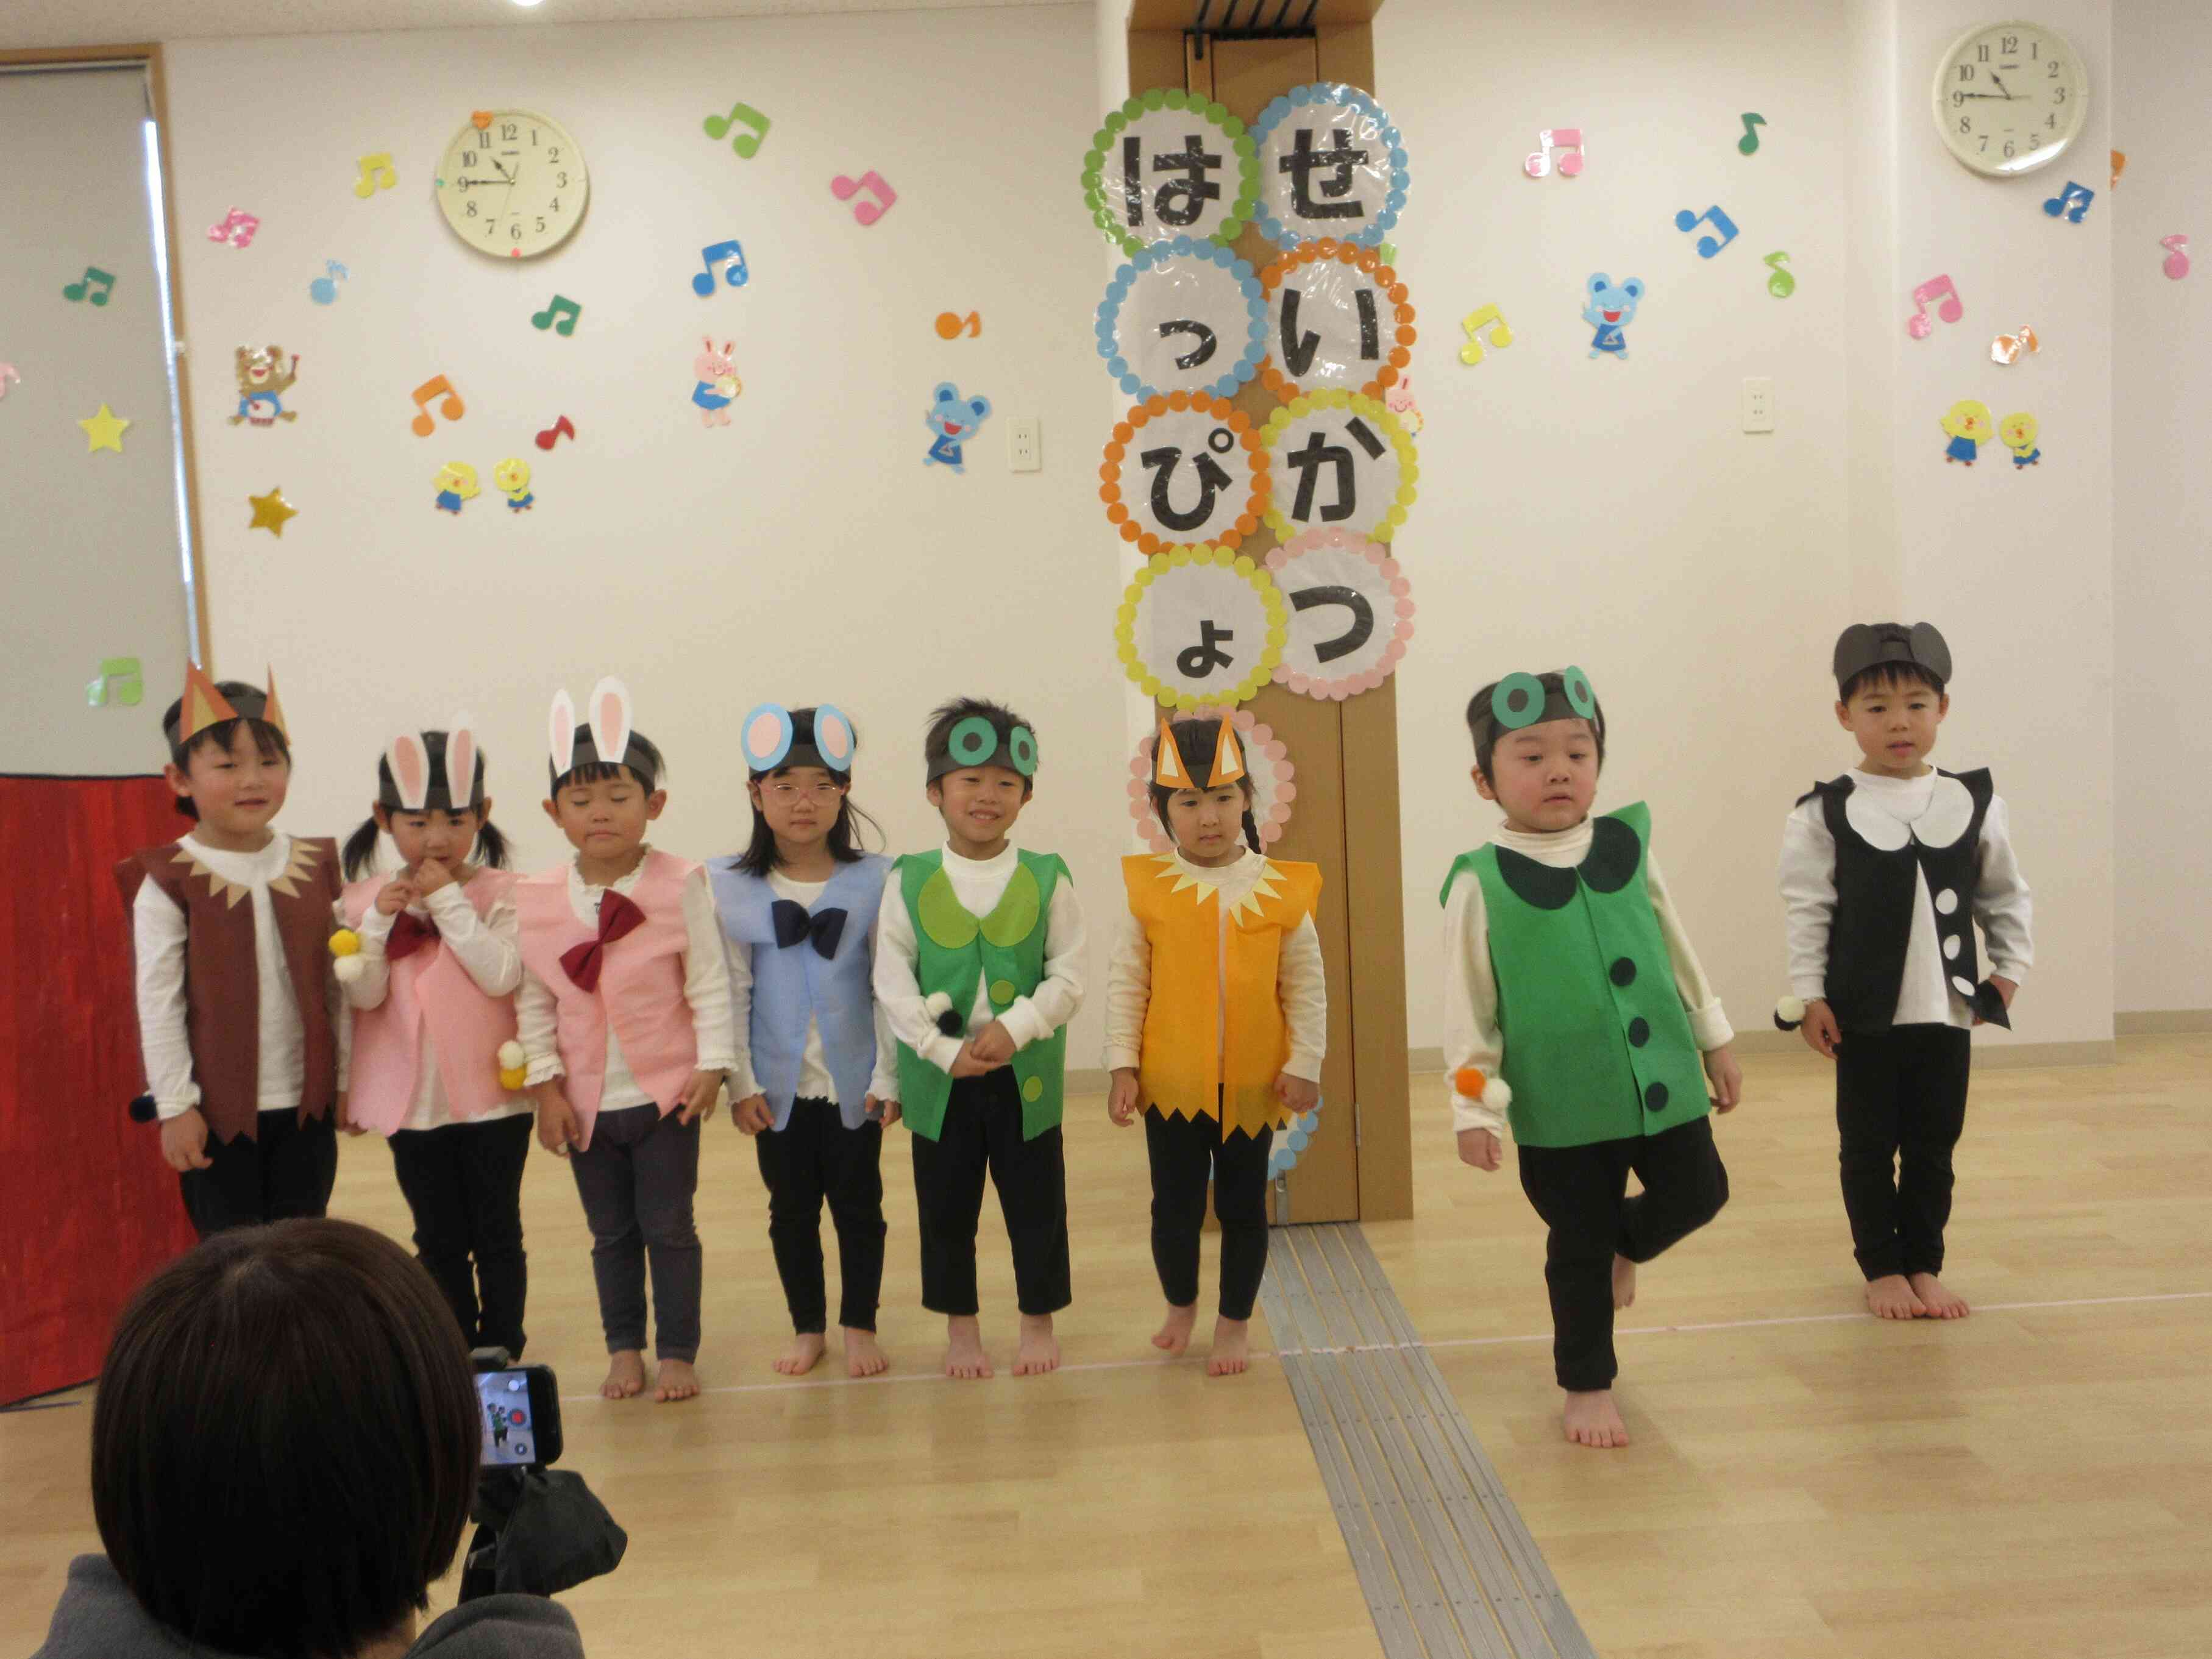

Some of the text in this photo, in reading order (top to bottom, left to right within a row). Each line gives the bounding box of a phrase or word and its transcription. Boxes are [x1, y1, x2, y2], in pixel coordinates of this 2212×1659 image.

[1978, 44, 1989, 62] 11
[2000, 36, 2018, 54] 12
[2032, 42, 2037, 59] 1
[1959, 63, 1974, 82] 10
[2047, 61, 2058, 78] 2
[1952, 91, 1963, 108] 9
[2053, 87, 2065, 104] 3
[1960, 116, 1971, 133] 8
[2045, 113, 2055, 129] 4
[479, 131, 491, 149] 11
[502, 123, 517, 141] 12
[532, 129, 538, 146] 1
[1979, 135, 1989, 152] 7
[2004, 141, 2015, 158] 6
[2029, 133, 2040, 151] 5
[463, 151, 477, 168] 10
[548, 147, 559, 163] 2
[458, 176, 468, 193] 9
[557, 171, 567, 188] 3
[466, 201, 477, 218] 8
[549, 197, 559, 212] 4
[485, 219, 495, 234] 7
[511, 223, 521, 240] 6
[535, 216, 545, 232] 5
[1279, 129, 1386, 664] せいかつ
